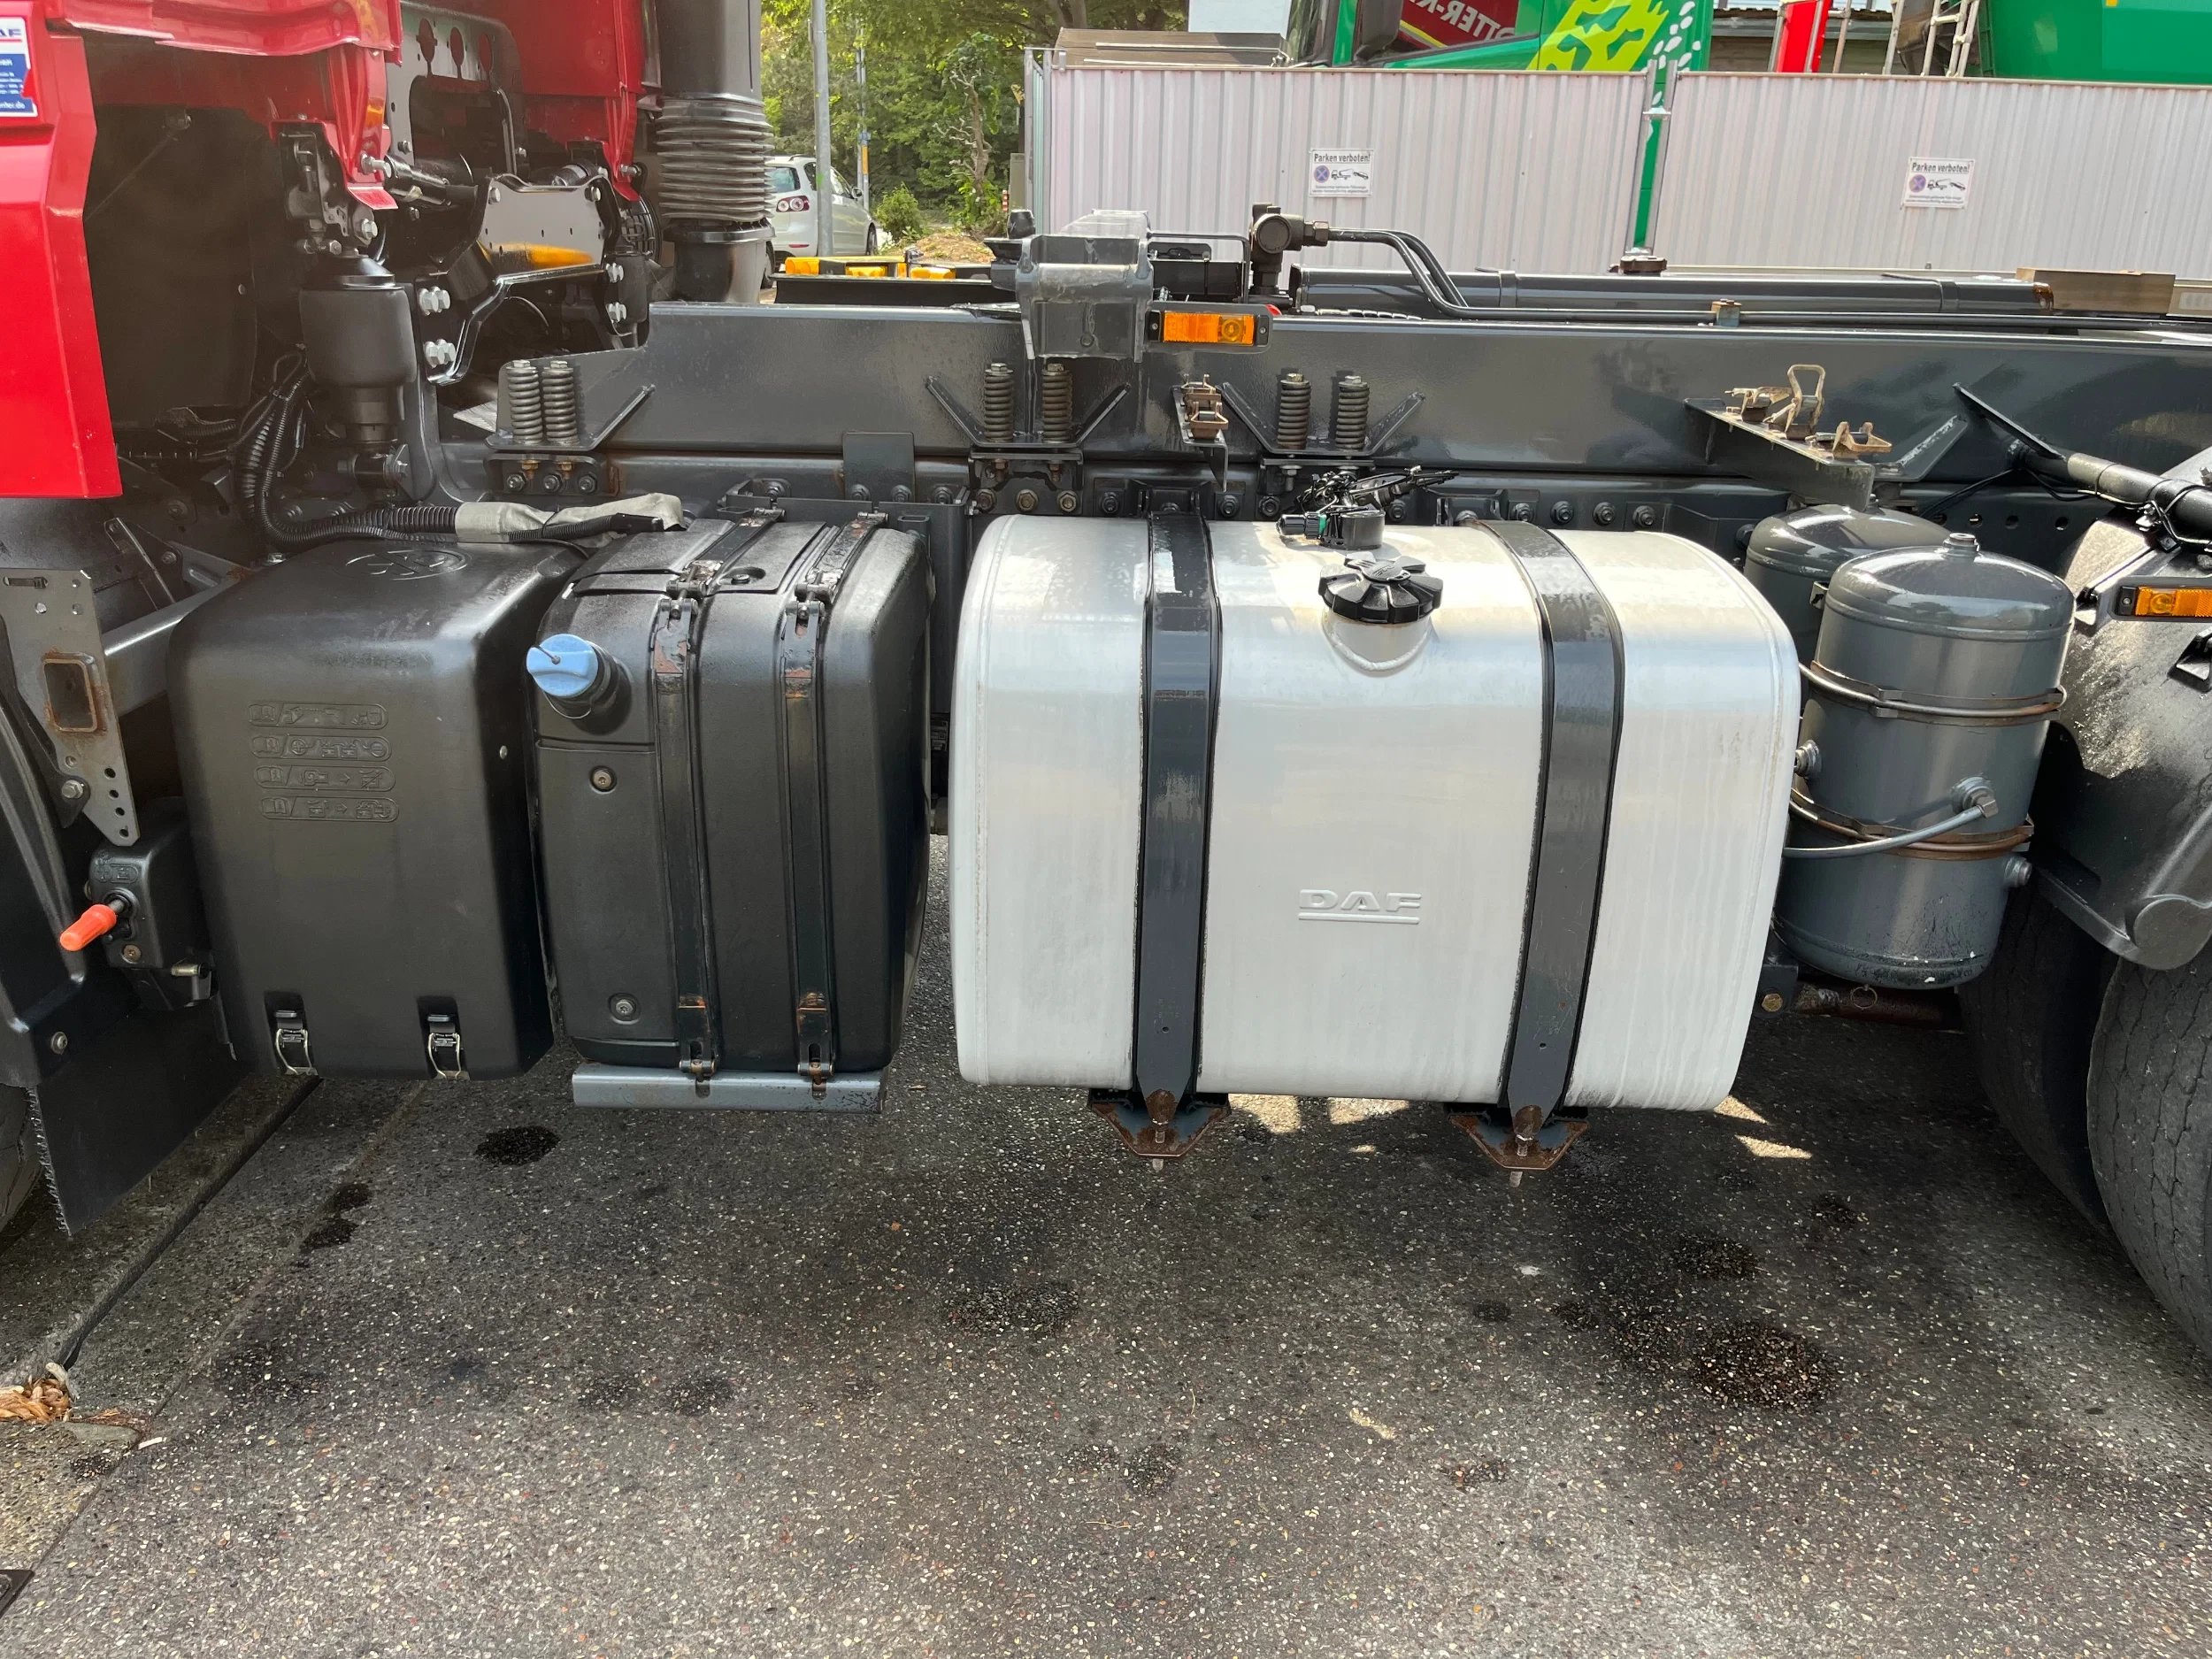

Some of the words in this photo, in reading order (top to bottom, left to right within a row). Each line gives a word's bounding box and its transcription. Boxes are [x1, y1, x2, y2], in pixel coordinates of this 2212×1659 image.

[1314, 153, 1337, 162] Parken
[1339, 153, 1371, 162] verboten!
[1911, 162, 1936, 172] Parken
[1938, 163, 1970, 173] verboten!
[1300, 888, 1422, 912] DAF
